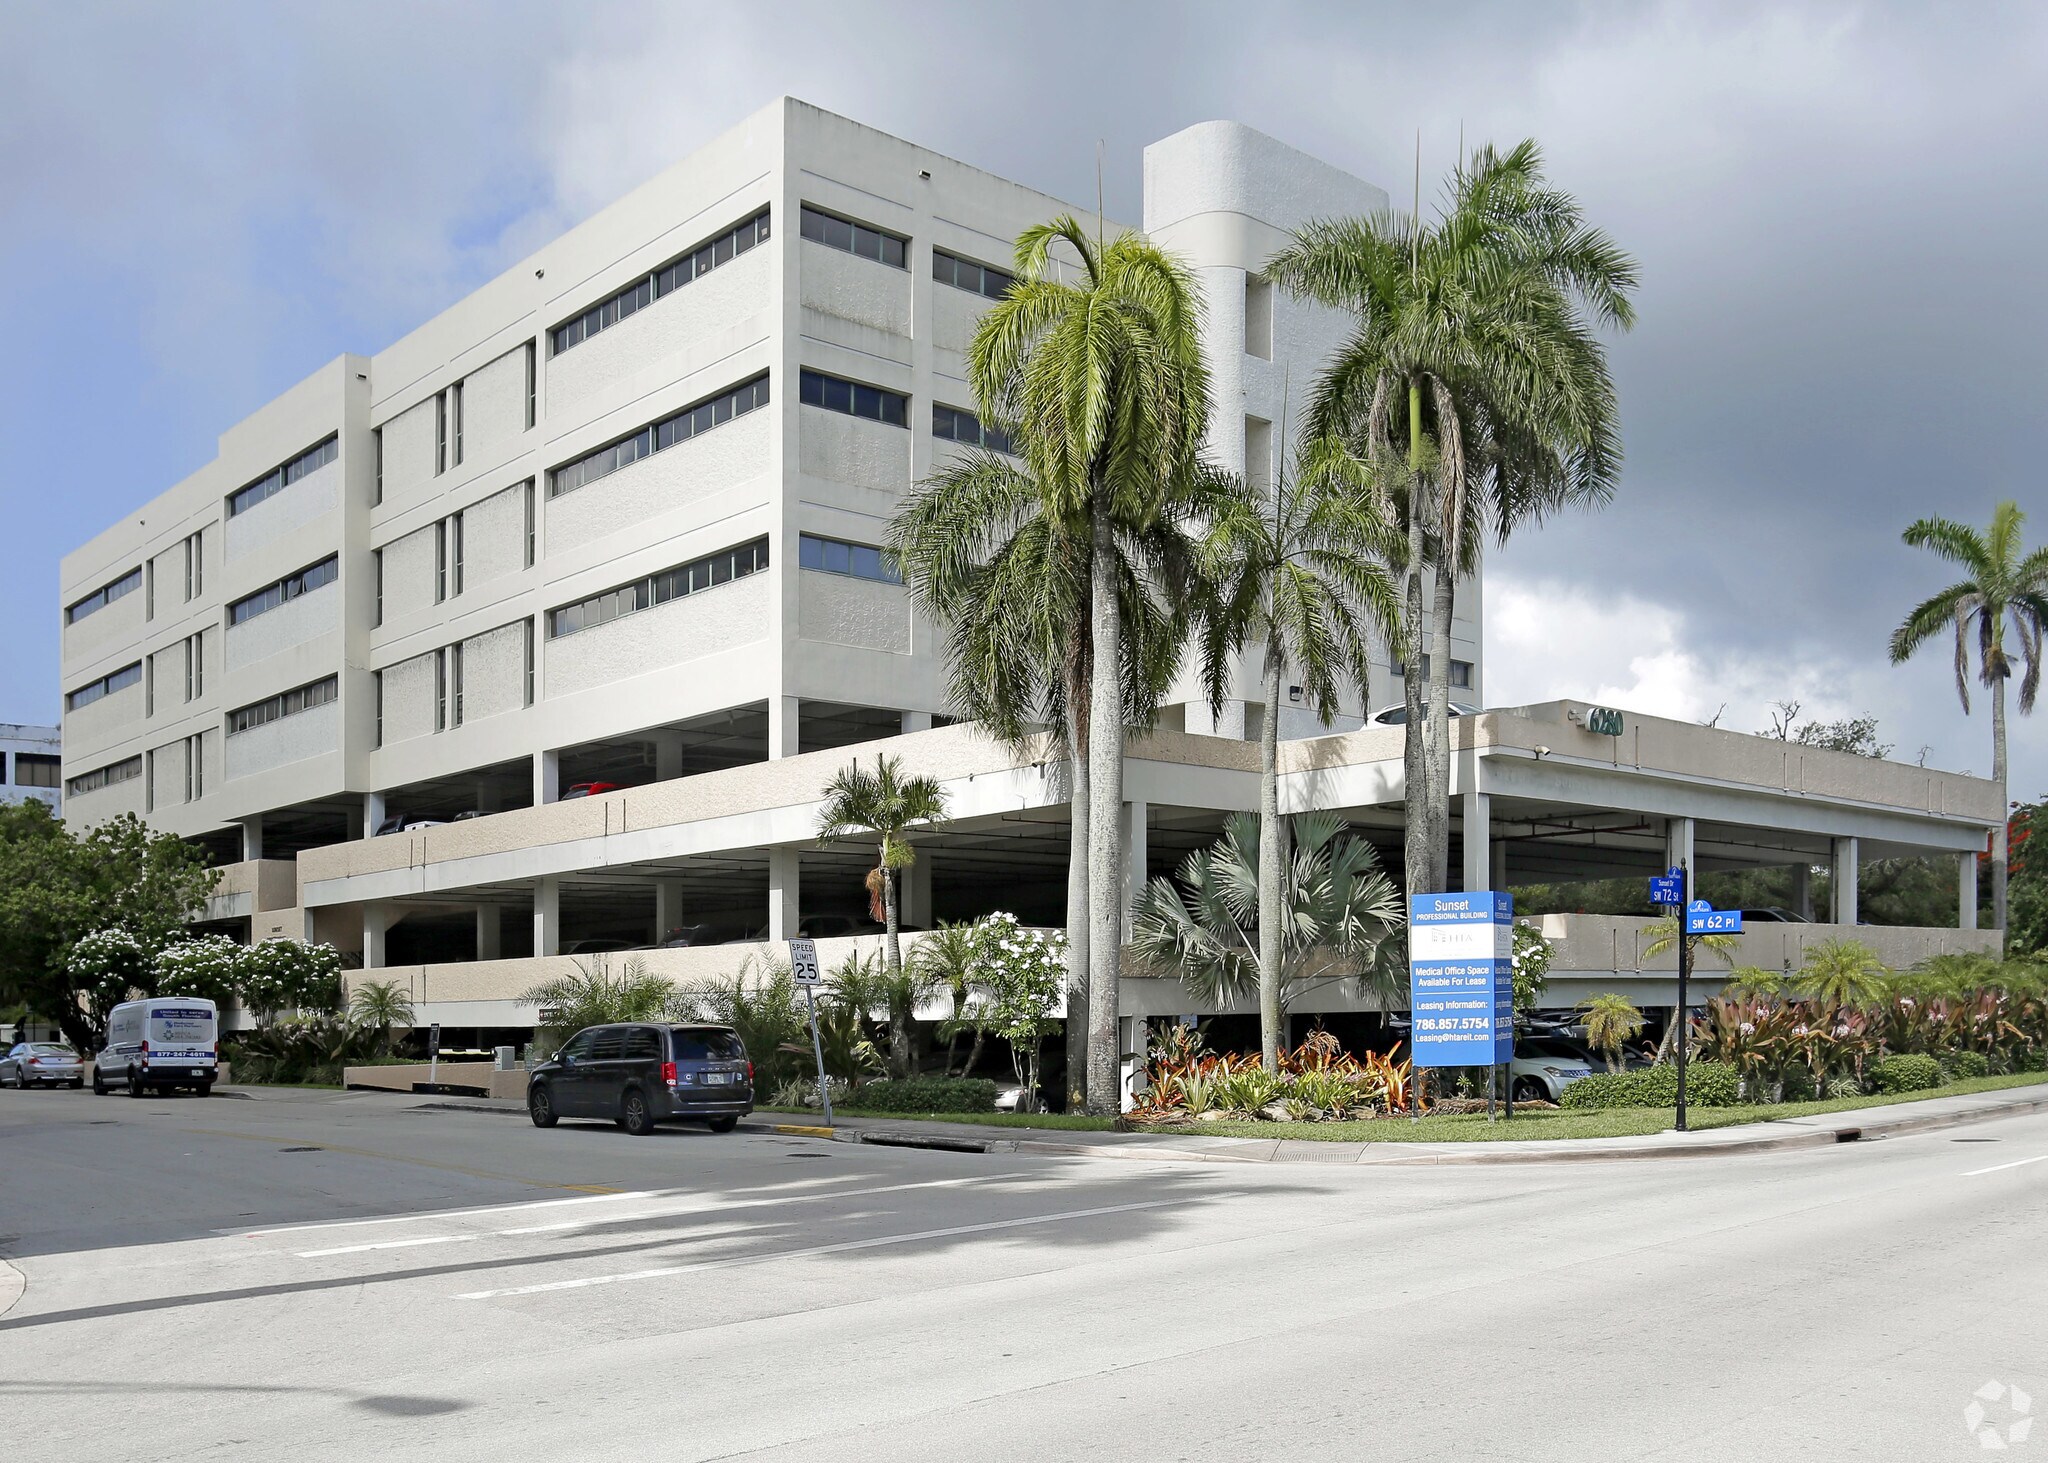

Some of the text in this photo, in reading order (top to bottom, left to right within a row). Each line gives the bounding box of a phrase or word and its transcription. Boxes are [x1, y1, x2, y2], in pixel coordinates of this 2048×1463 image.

[1654, 889, 1679, 902] SW 72 St
[1435, 899, 1469, 912] Sunset
[1416, 912, 1459, 921] PROFESSIONAL
[1460, 911, 1488, 920] BUILDING
[1692, 919, 1705, 929] SW
[1707, 915, 1722, 929] 62
[791, 944, 814, 952] SPEED
[795, 953, 812, 961] LIMIT
[795, 962, 817, 980] 25
[1415, 967, 1443, 976] Medical
[1444, 966, 1466, 975] Office
[1467, 966, 1490, 976] Space
[1418, 977, 1487, 987] Available For Lease
[1416, 1001, 1444, 1011] Leasing
[1445, 1000, 1488, 1009] Information:
[1415, 1017, 1490, 1031] 786.857.5754
[1415, 1033, 1490, 1043] Leasing@htareit.com
